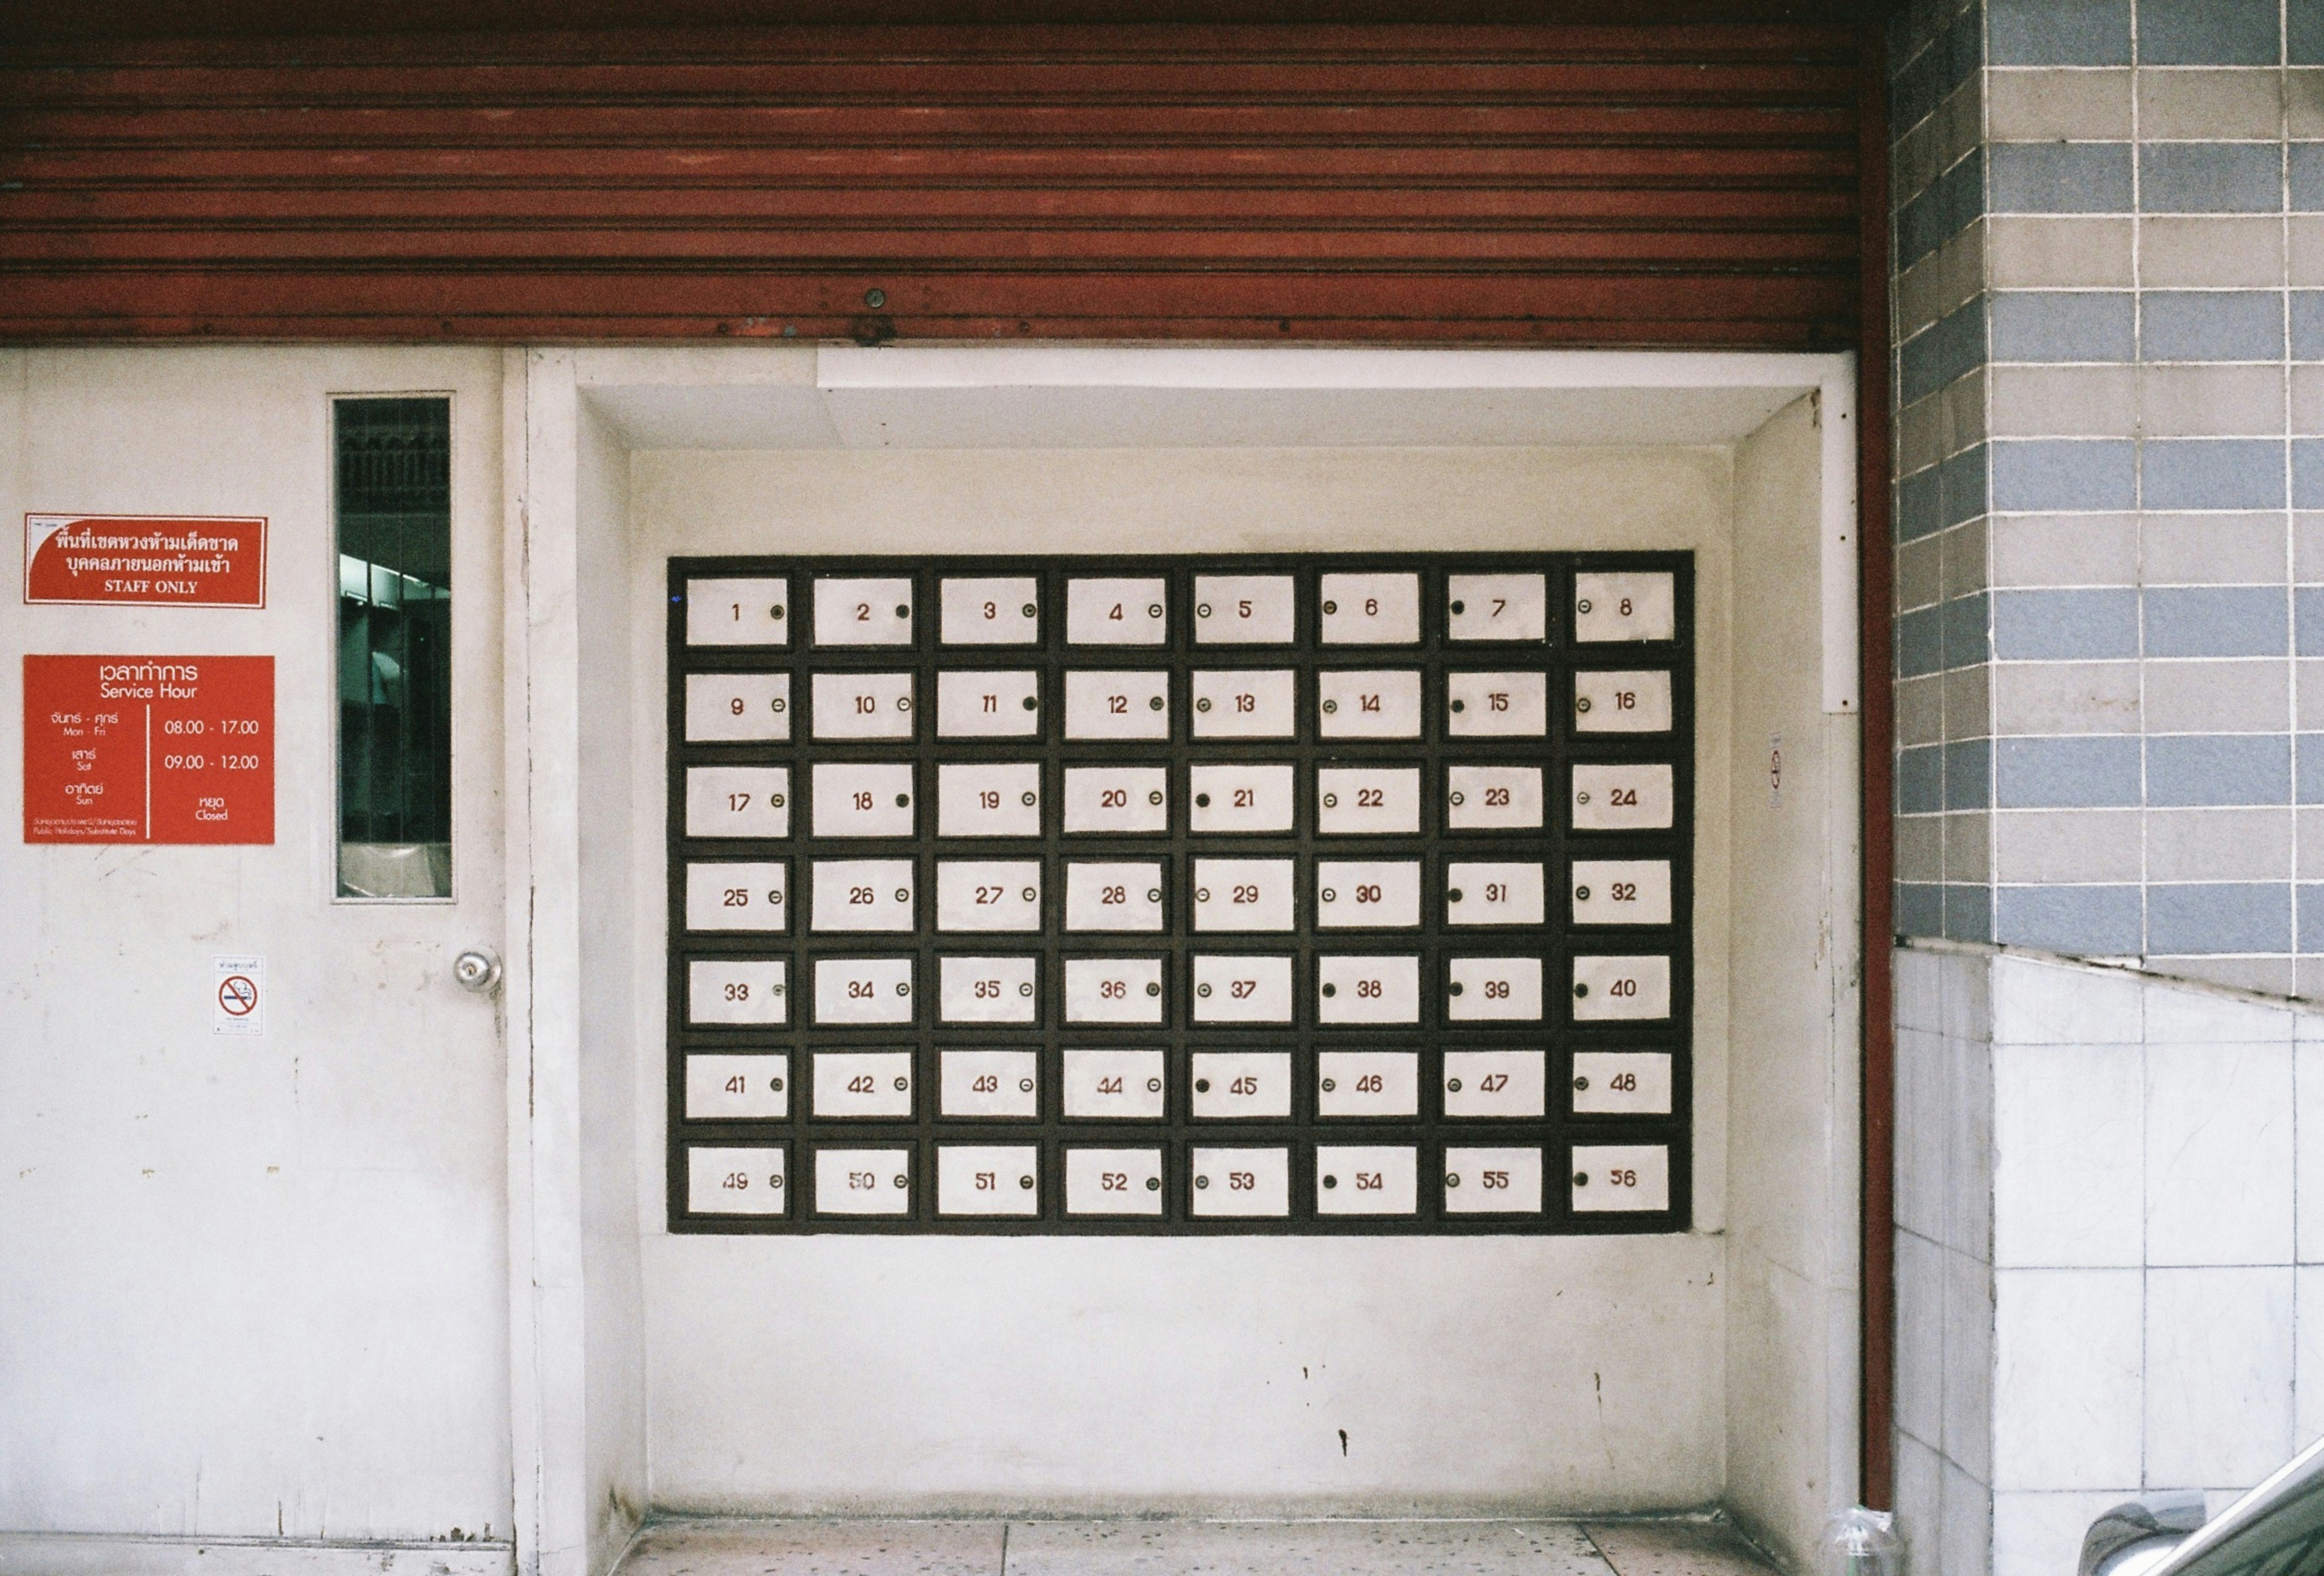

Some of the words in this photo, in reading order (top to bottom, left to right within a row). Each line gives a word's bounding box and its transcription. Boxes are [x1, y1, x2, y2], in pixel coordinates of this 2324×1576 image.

[55, 527, 238, 551] พื้นที่เขตหวงห้ามเด็ดขาด
[66, 554, 229, 576] บุคคลภายนอกห้ามเข้า
[105, 580, 150, 593] STAFF
[156, 581, 198, 593] ONLY
[732, 602, 740, 622] 1
[855, 602, 871, 622] 2
[983, 600, 997, 620] 3
[1108, 602, 1124, 621] 4
[1238, 599, 1253, 619] 5
[1364, 597, 1379, 617] 6
[1491, 598, 1507, 618] 7
[1619, 597, 1633, 617] 8
[100, 660, 198, 680] เวลาทำการ
[101, 682, 153, 698] Service
[160, 682, 197, 698] Hour
[730, 697, 745, 717] 9
[854, 695, 876, 715] 10
[982, 694, 997, 713] 11
[1107, 694, 1128, 714] 12
[1235, 692, 1256, 713] 13
[1359, 693, 1381, 713] 14
[1487, 692, 1510, 712] 15
[1614, 691, 1636, 711] 16
[51, 712, 81, 724] จันทร์
[95, 712, 118, 726] ศุกร์
[165, 720, 204, 734] 08.00
[221, 720, 258, 734] 17.00
[63, 727, 84, 736] Mon
[94, 726, 106, 735] Fri
[72, 748, 96, 759] เสาร์
[165, 755, 204, 769] 09.00
[221, 755, 258, 769] 12.00
[77, 761, 92, 771] Sat
[65, 783, 103, 794] อาทิตย์
[1100, 788, 1128, 808] 20
[1233, 788, 1254, 808] 21
[1357, 788, 1384, 808] 22
[1484, 787, 1511, 807] 23
[1610, 788, 1638, 807] 24
[77, 795, 92, 804] Sun
[199, 797, 224, 810] หยุด
[728, 792, 752, 812] 17
[852, 791, 874, 811] 18
[979, 790, 1000, 810] 19
[196, 809, 228, 820] Closed
[723, 888, 749, 908] 25
[849, 886, 875, 905] 26
[975, 885, 1004, 905] 27
[1101, 884, 1127, 905] 28
[1232, 884, 1260, 904] 29
[1355, 884, 1382, 904] 30
[1485, 882, 1507, 903] 31
[1611, 882, 1637, 902] 32
[724, 983, 749, 1002] 33
[847, 980, 875, 999] 34
[974, 979, 1001, 999] 35
[1100, 980, 1127, 1000] 36
[1230, 980, 1257, 1000] 37
[1356, 979, 1383, 999] 38
[1484, 980, 1511, 1000] 39
[1610, 978, 1637, 997] 40
[724, 1075, 746, 1094] 41
[846, 1075, 875, 1094] 42
[971, 1075, 998, 1094] 43
[1096, 1076, 1123, 1095] 44
[1229, 1075, 1258, 1096] 45
[1355, 1074, 1383, 1094] 46
[1479, 1073, 1509, 1093] 47
[1609, 1072, 1637, 1093] 48
[722, 1172, 749, 1191] 49
[848, 1171, 876, 1191] 50
[975, 1171, 996, 1191] 51
[1101, 1172, 1128, 1192] 52
[1228, 1171, 1255, 1191] 53
[1355, 1172, 1384, 1191] 54
[1482, 1170, 1510, 1190] 55
[1610, 1169, 1637, 1188] 56
